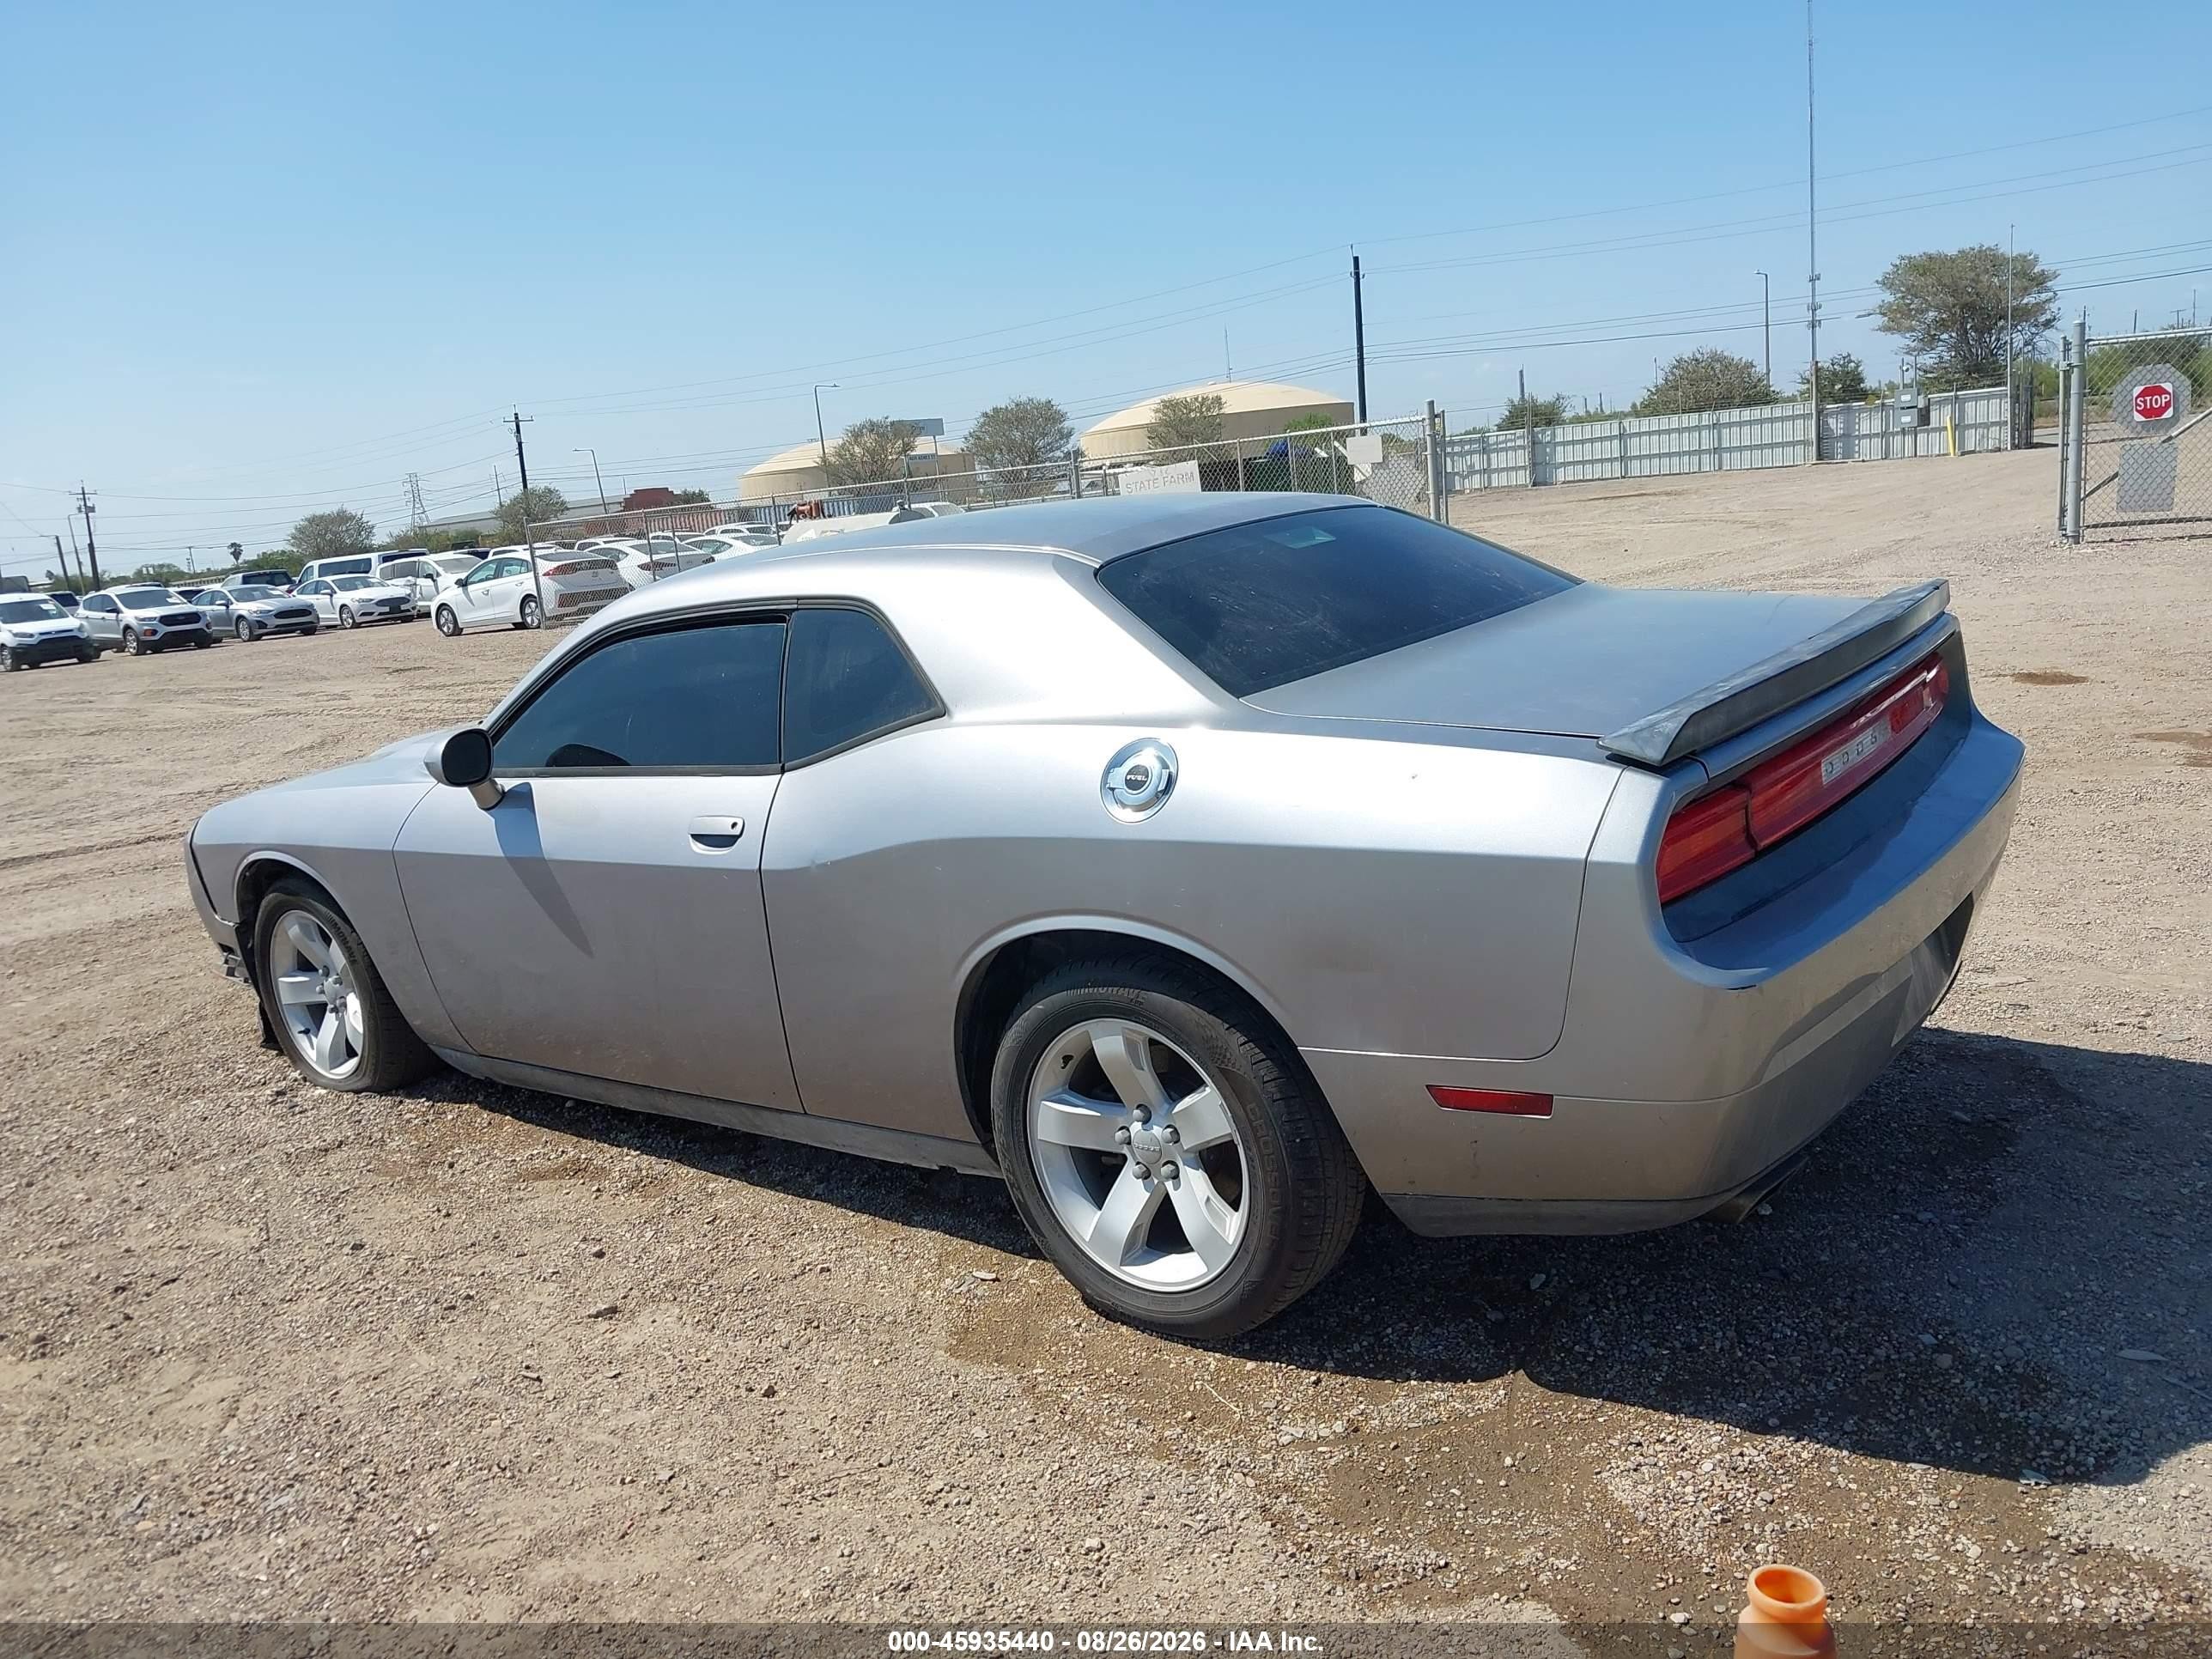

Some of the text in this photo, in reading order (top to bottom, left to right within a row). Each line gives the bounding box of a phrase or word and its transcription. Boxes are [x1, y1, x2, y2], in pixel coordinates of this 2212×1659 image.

[2136, 394, 2170, 410] STOP
[1126, 472, 1194, 494] STATE FARM
